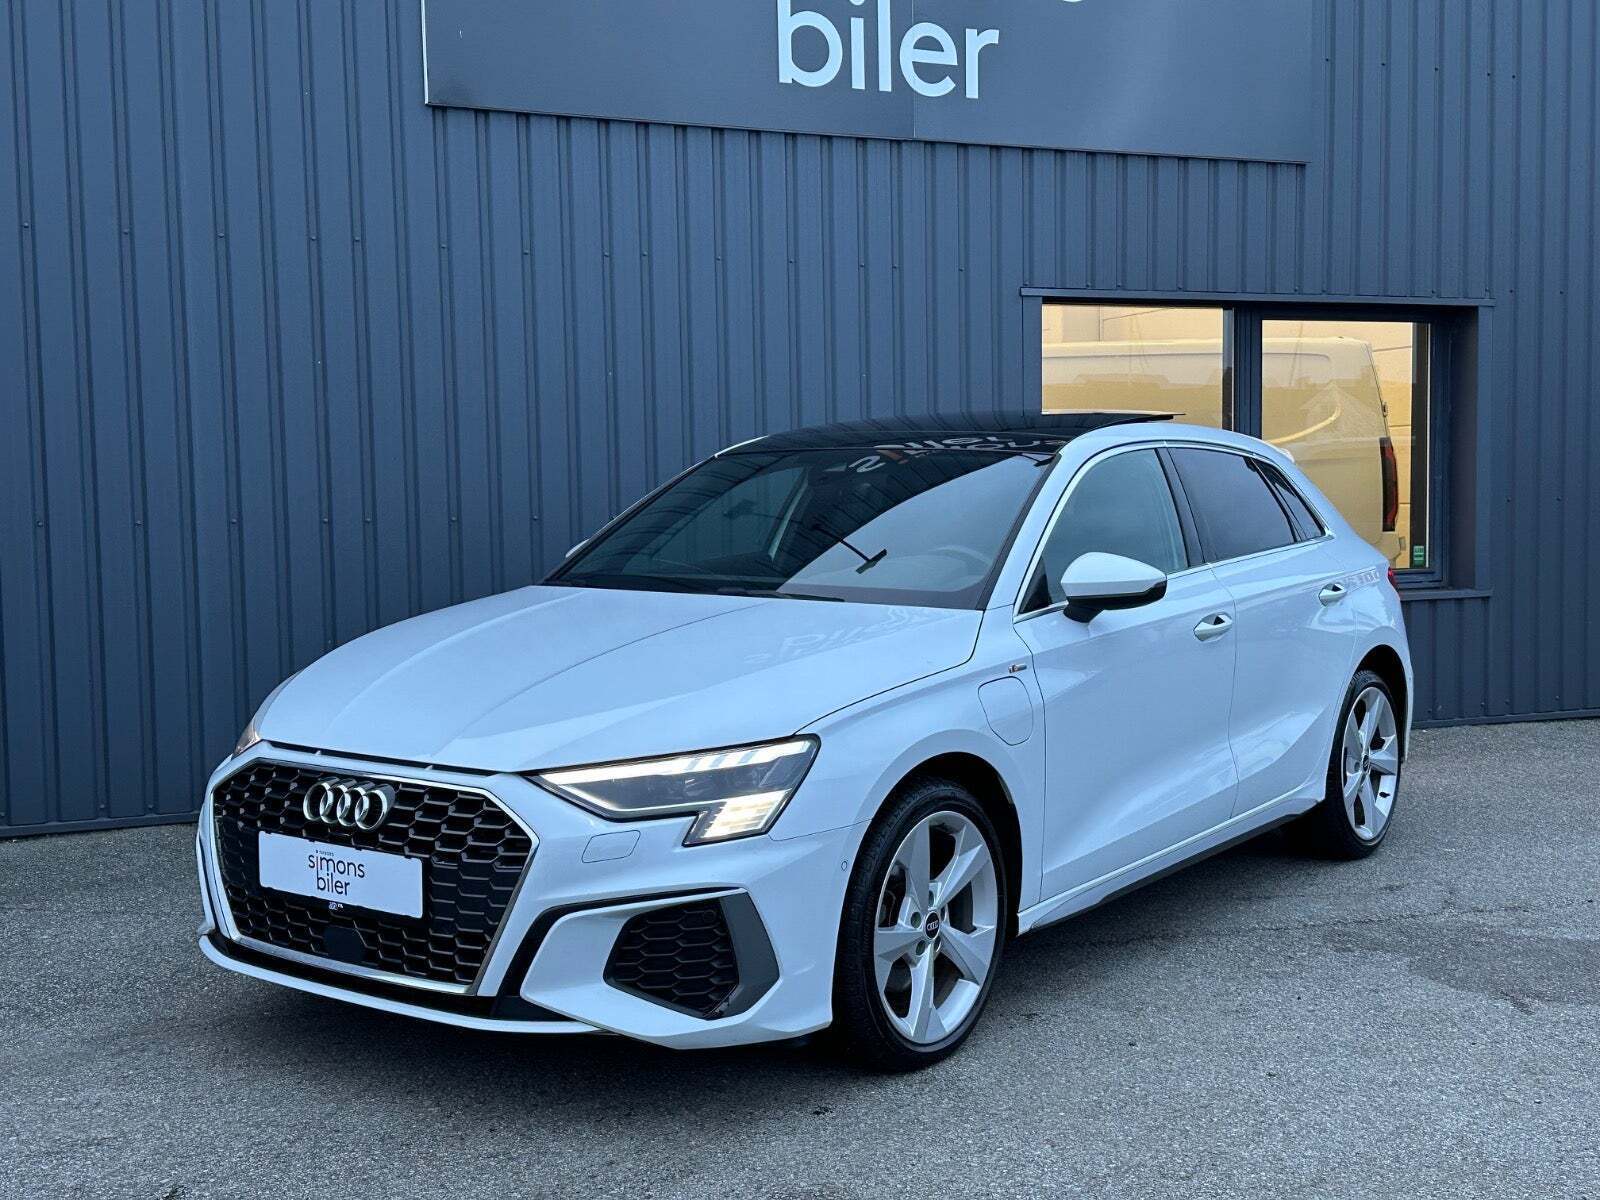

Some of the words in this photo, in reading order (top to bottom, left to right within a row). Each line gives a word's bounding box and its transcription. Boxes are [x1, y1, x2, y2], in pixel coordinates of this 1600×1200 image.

[778, 0, 999, 99] biler
[308, 850, 365, 878] simons
[316, 869, 350, 896] biler
